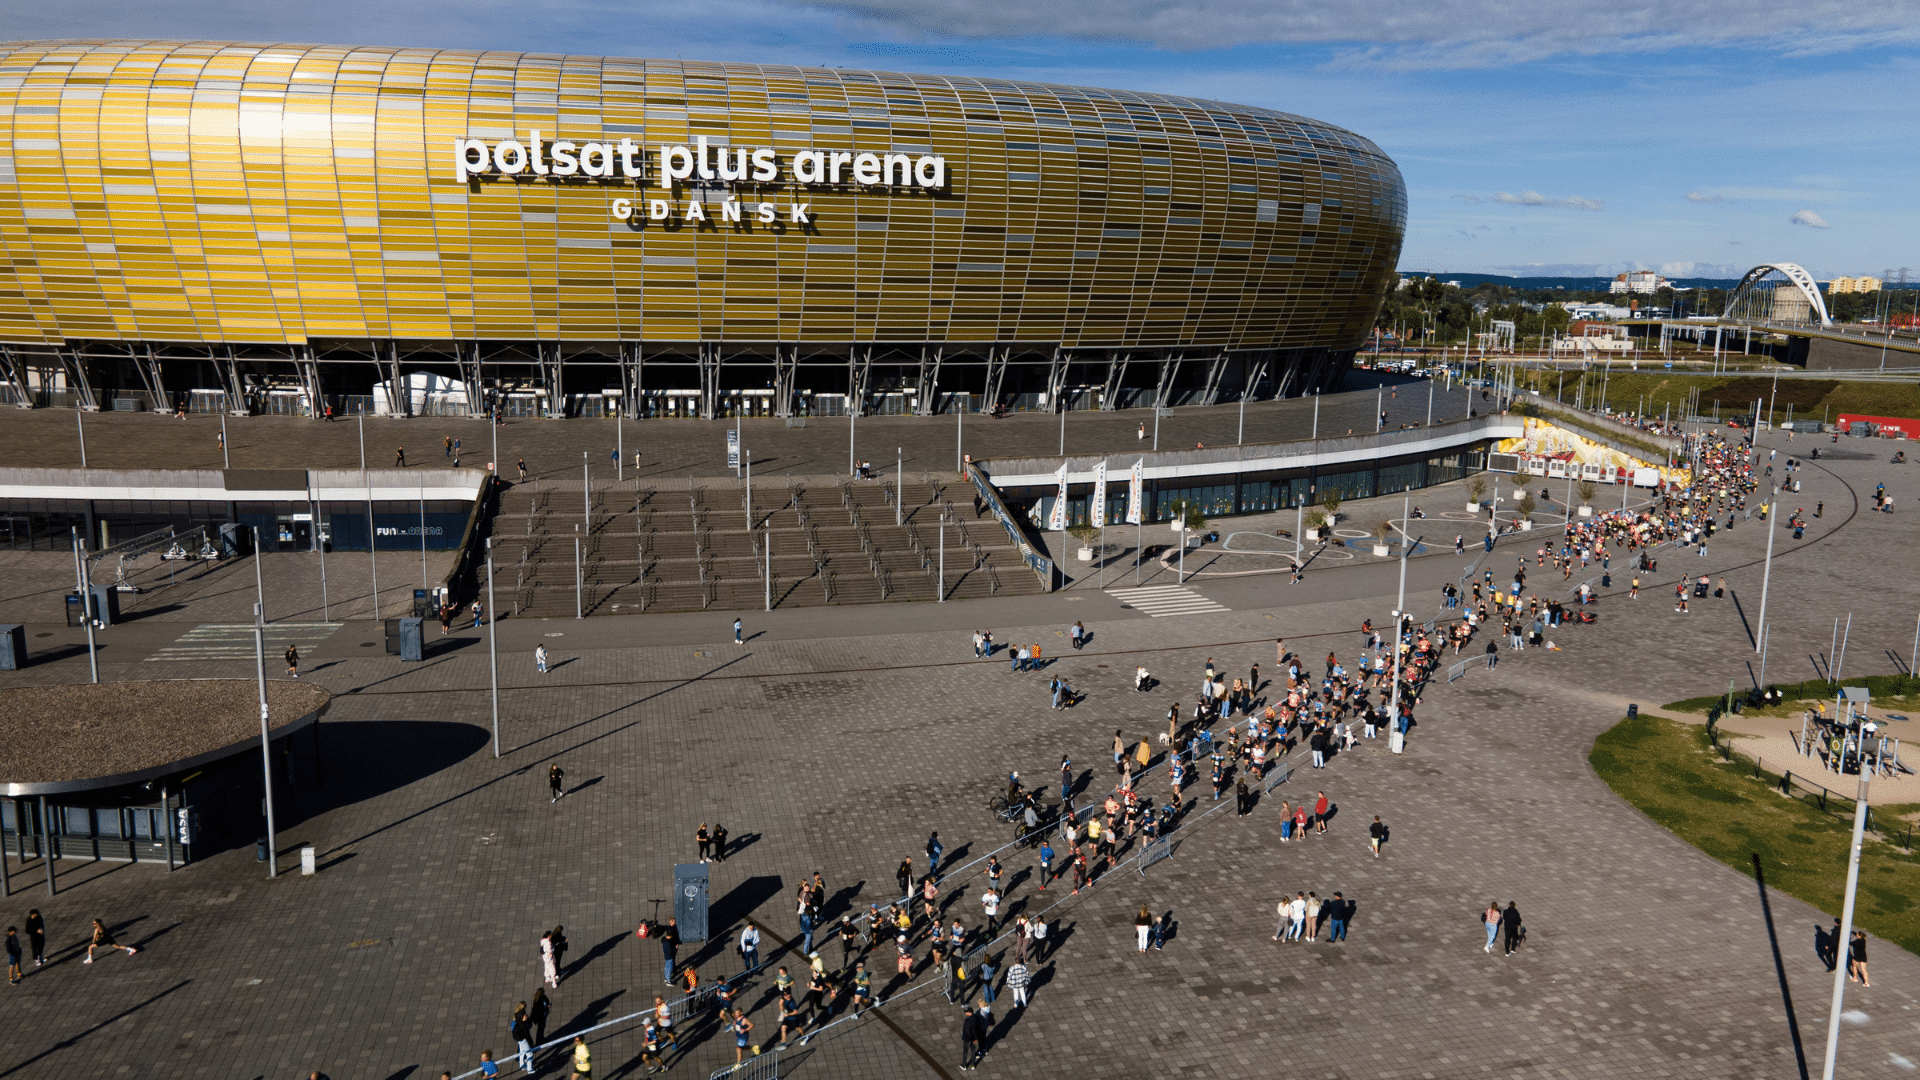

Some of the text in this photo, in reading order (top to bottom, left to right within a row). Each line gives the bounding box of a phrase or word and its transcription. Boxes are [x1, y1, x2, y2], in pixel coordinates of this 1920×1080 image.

[454, 129, 945, 189] polsat plus arena
[611, 195, 810, 224] GDAŃSK
[376, 527, 397, 536] FUN
[178, 809, 188, 843] KASA
